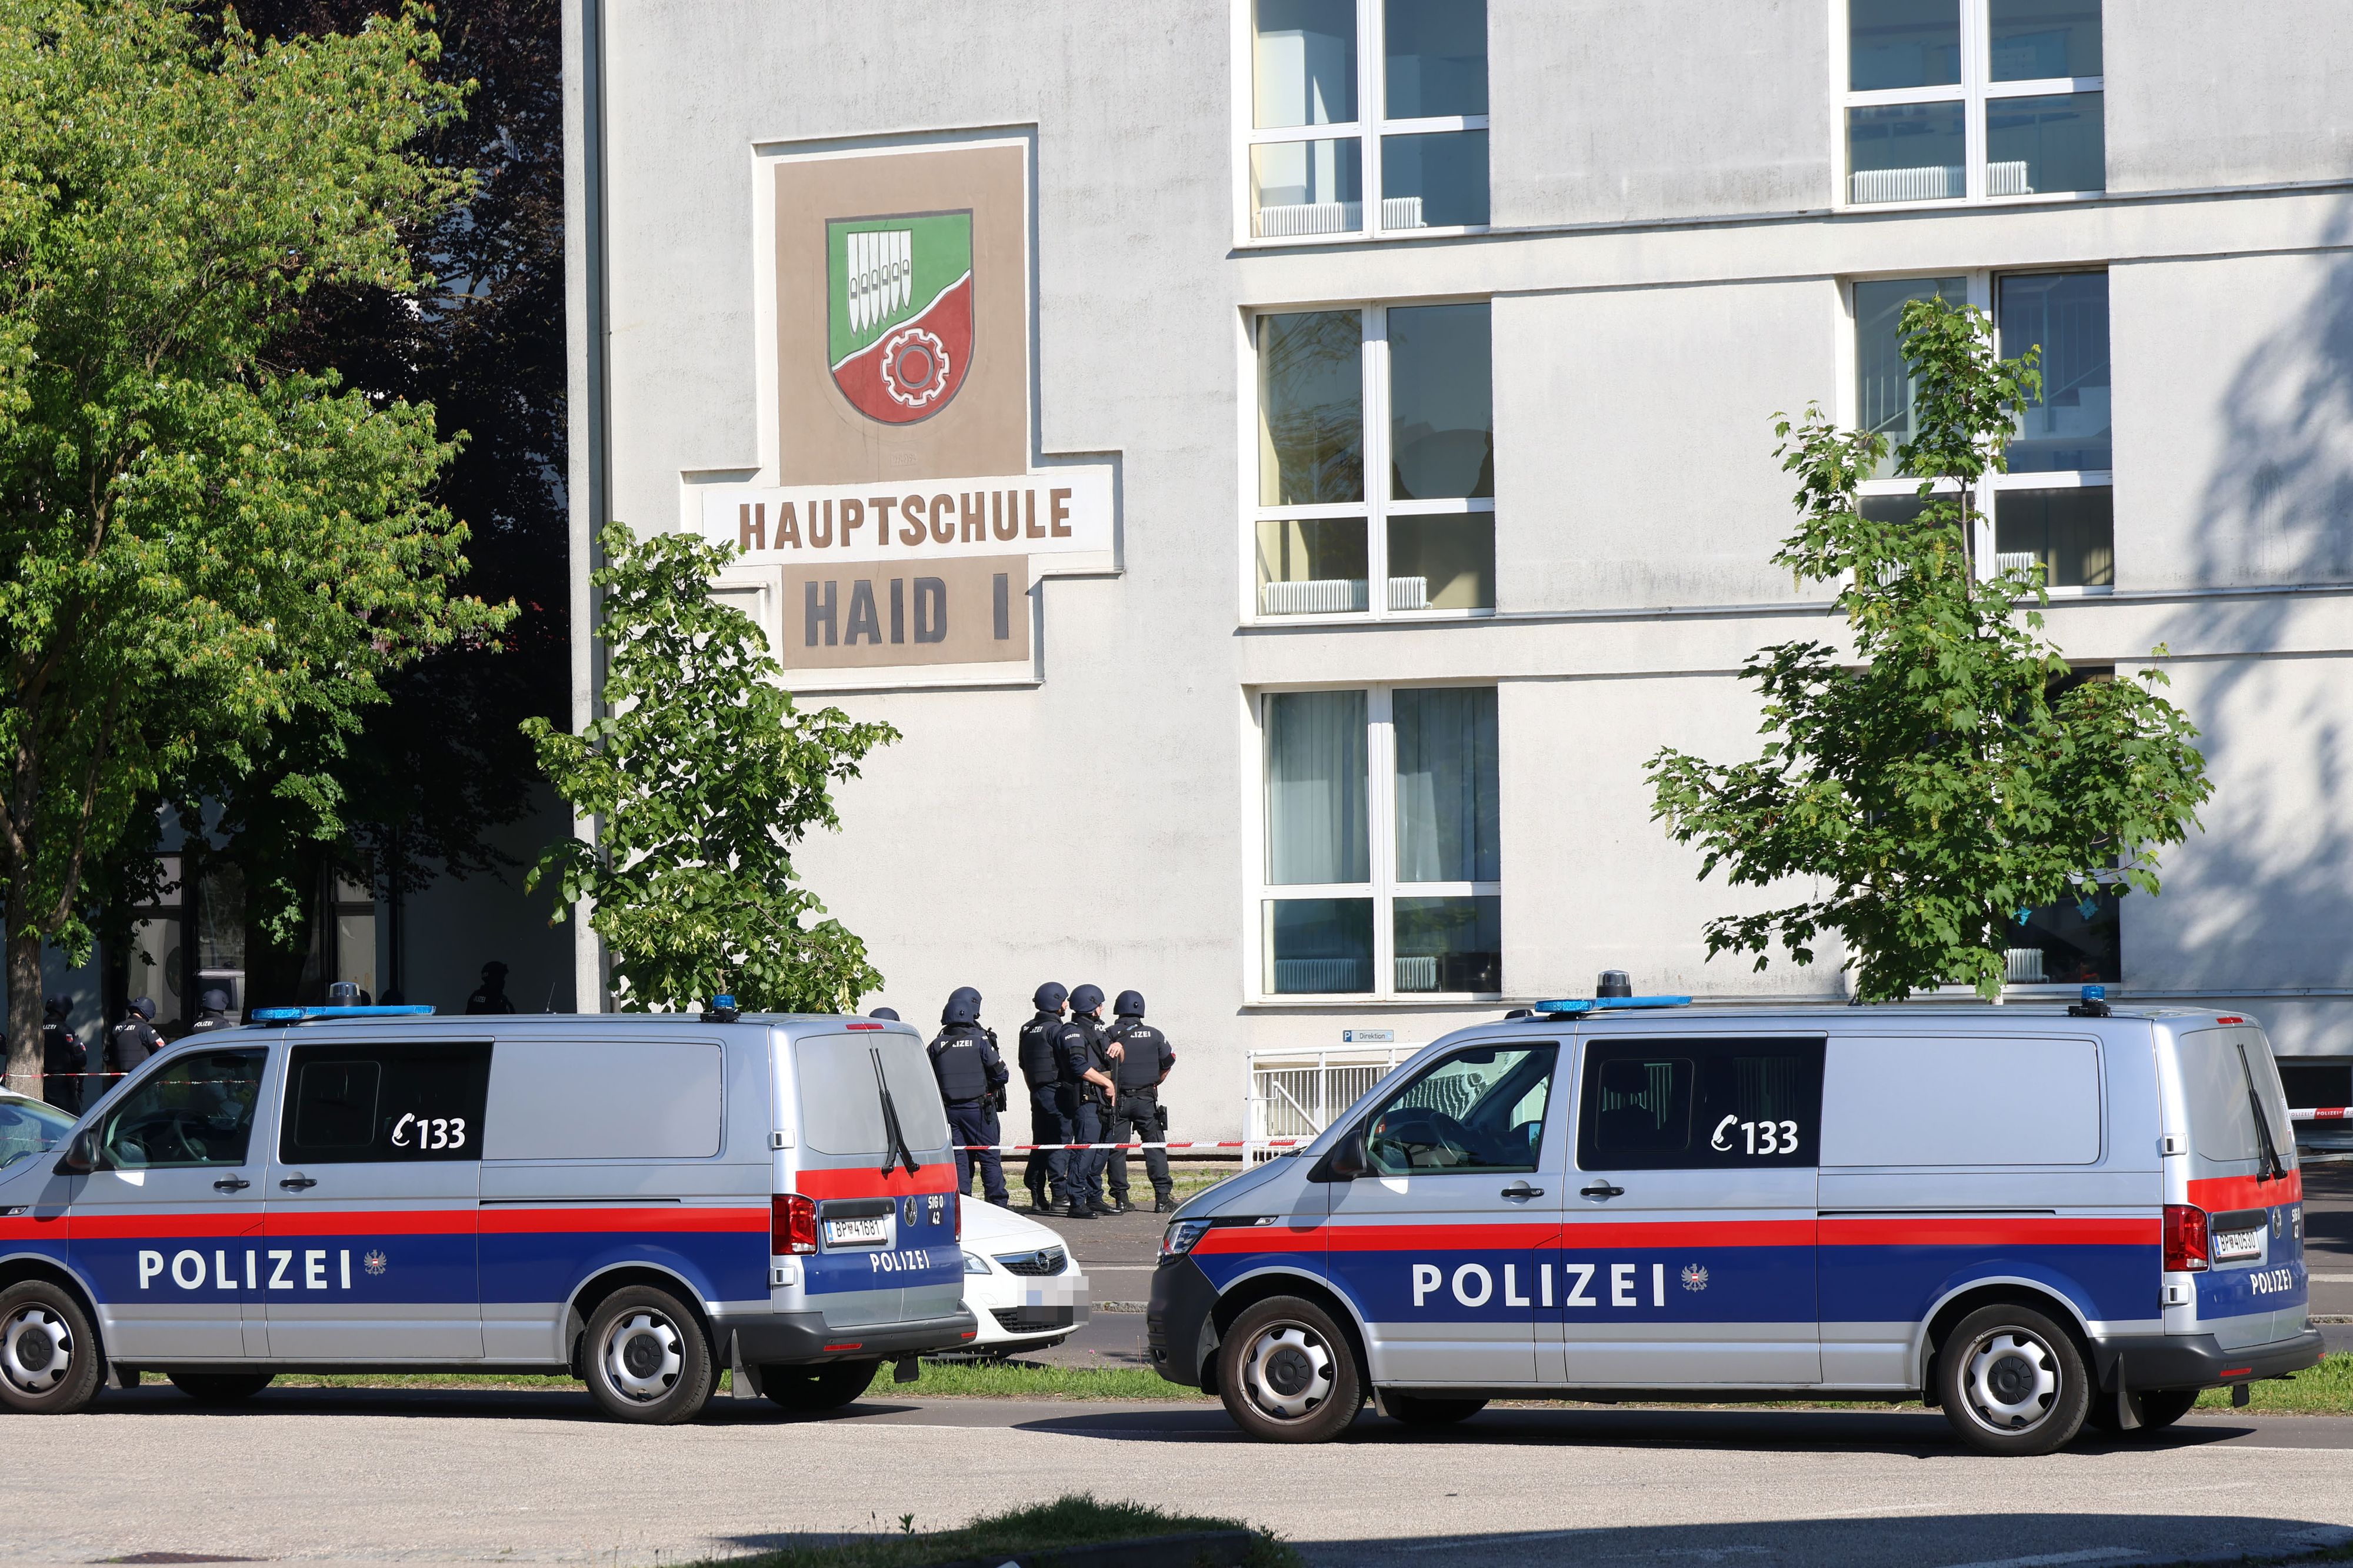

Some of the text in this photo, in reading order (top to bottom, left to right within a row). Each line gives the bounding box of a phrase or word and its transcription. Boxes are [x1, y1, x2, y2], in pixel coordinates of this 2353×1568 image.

[739, 488, 1072, 551] HAUPTSCHULE
[804, 573, 1009, 647] HAID I
[416, 1118, 465, 1149] 133
[1741, 1120, 1798, 1155] 133
[928, 1195, 938, 1209] SIG
[836, 1221, 847, 1237] BP
[854, 1220, 880, 1236] 41681
[932, 1211, 940, 1225] 42
[2219, 1234, 2229, 1252] BP
[2234, 1231, 2256, 1251] 40530
[138, 1249, 351, 1290] POLIZEI
[869, 1249, 930, 1273] POLIZEI
[1412, 1263, 1665, 1307] POLIZEI
[2249, 1268, 2292, 1295] POLIZEI
